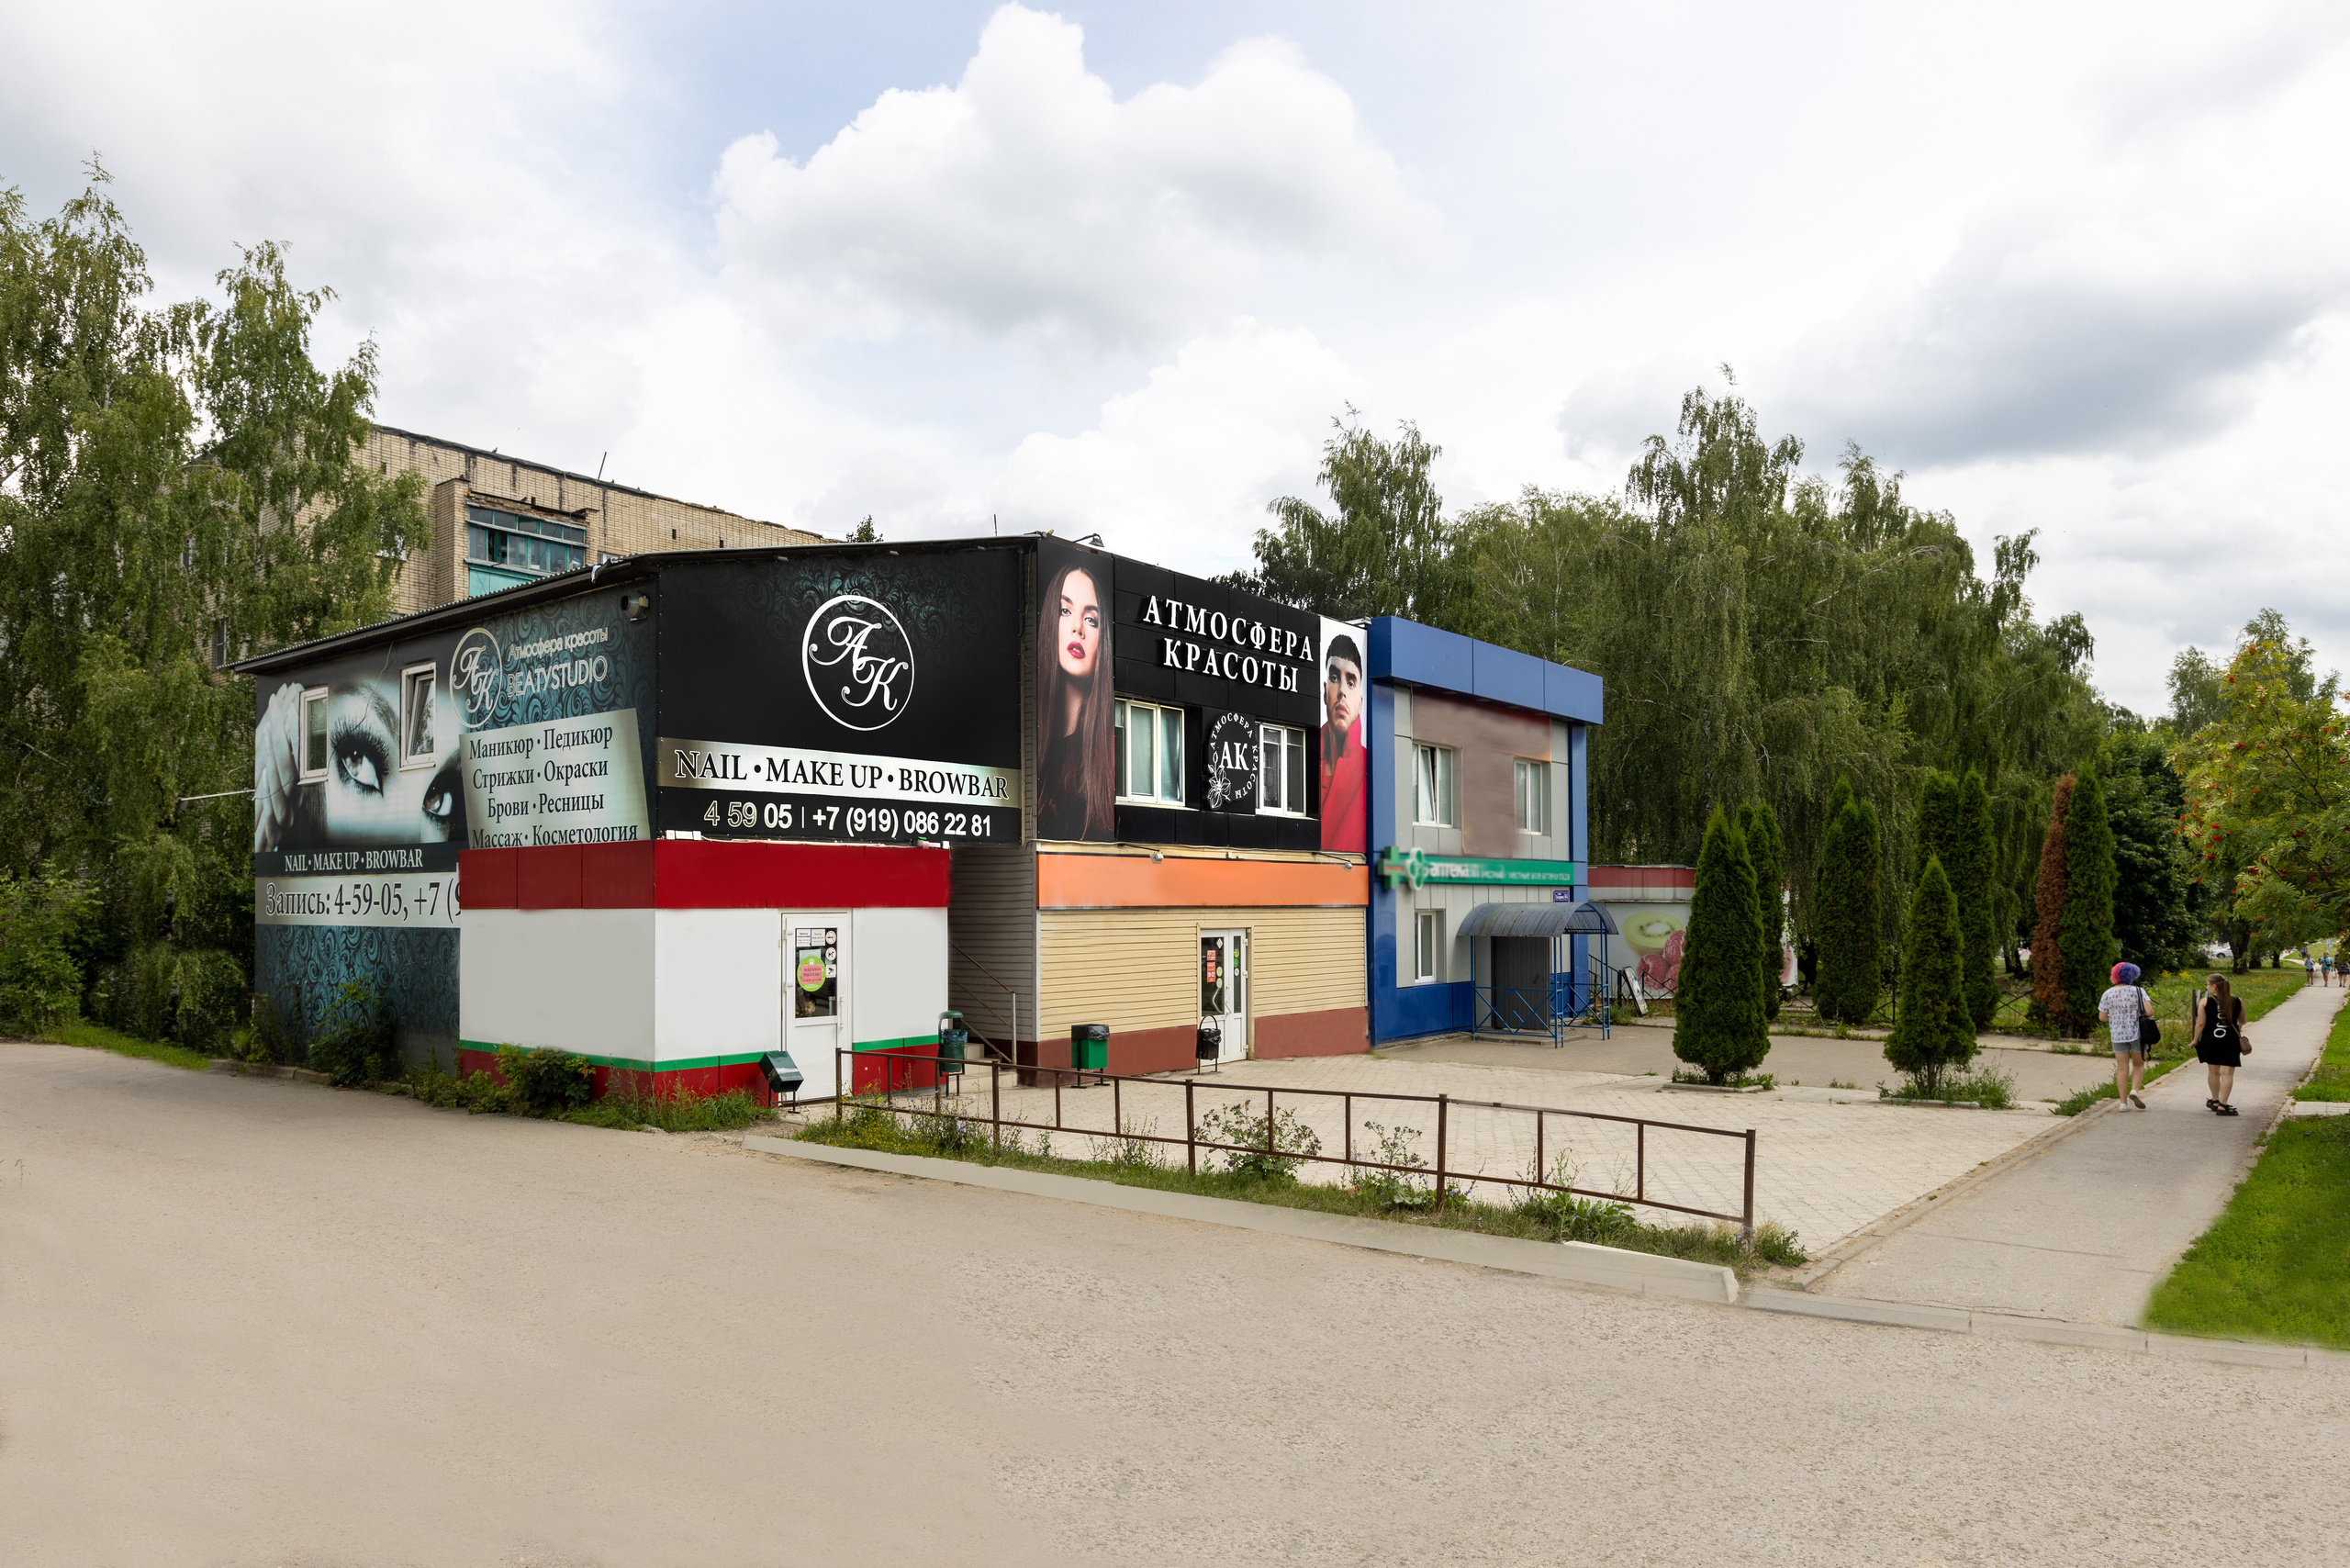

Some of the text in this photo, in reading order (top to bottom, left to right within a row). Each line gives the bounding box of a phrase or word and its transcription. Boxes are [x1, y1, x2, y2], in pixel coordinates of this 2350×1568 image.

[508, 627, 609, 662] Атмосфера красоты
[1143, 595, 1314, 662] АТМОСФЕРА
[508, 655, 608, 698] BEATYSTUDIO
[1163, 637, 1298, 693] КРАСОТЫ
[469, 725, 613, 760] Маникюр Педикюр
[1210, 712, 1253, 750] АТМОСФЕРА
[675, 749, 1009, 800] NAIL MAKE UP BROWBAR
[1218, 741, 1249, 771] АК
[1235, 745, 1259, 800] КРАСОТЫ
[473, 760, 609, 794] Стрижки Окраски
[487, 793, 604, 823] Брови Ресницы
[704, 801, 990, 838] 4 59 05 +7 (919) 086 22 81
[472, 824, 638, 849] Массаж Косметология
[285, 848, 424, 872] NAIL MAKE UP BROWBAR
[265, 882, 330, 916] Запись:
[334, 882, 408, 921] 4-59-05,
[413, 881, 441, 916] +7
